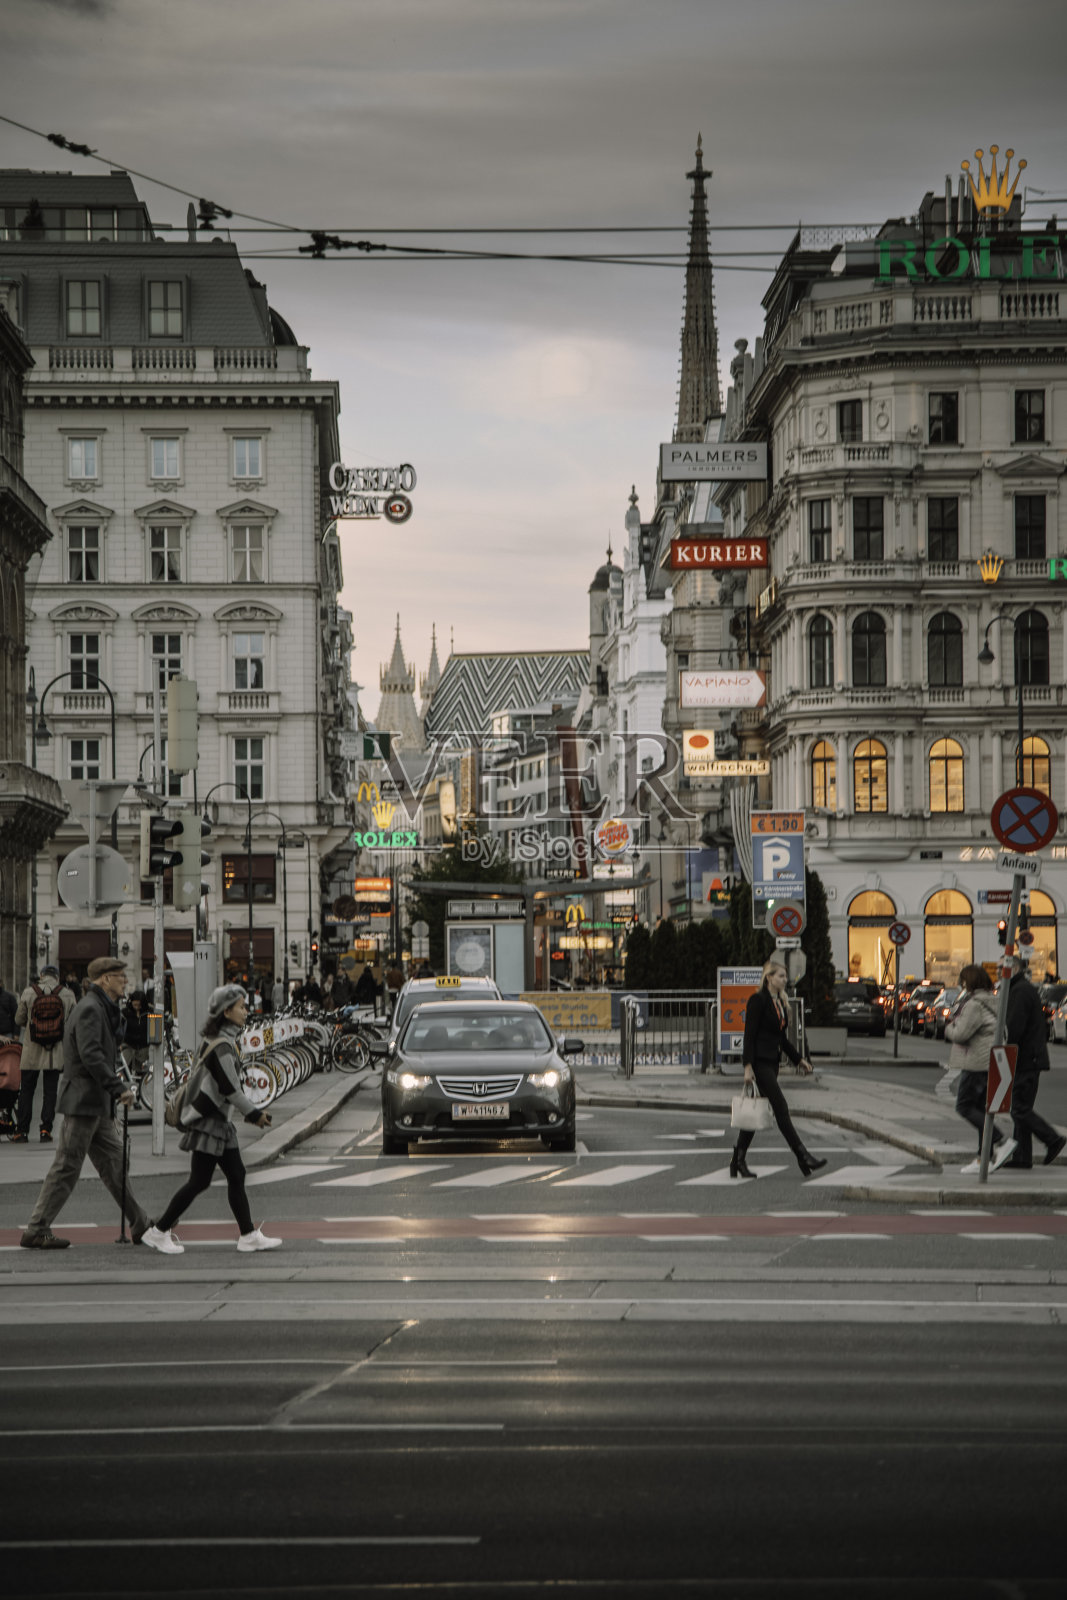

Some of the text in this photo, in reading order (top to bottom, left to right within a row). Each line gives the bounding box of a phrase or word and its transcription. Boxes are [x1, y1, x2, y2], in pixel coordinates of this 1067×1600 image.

[874, 236, 1067, 282] ROLE
[671, 450, 758, 463] PALMERS
[329, 462, 417, 492] CASINO
[329, 495, 379, 516] WIEN
[677, 545, 763, 562] KURIER
[685, 675, 750, 688] VAPIANO
[598, 824, 628, 837] BURGER
[354, 832, 418, 847] ROLEX
[600, 832, 630, 848] KING
[1002, 856, 1037, 872] Anfang
[568, 1014, 598, 1027] 1,90
